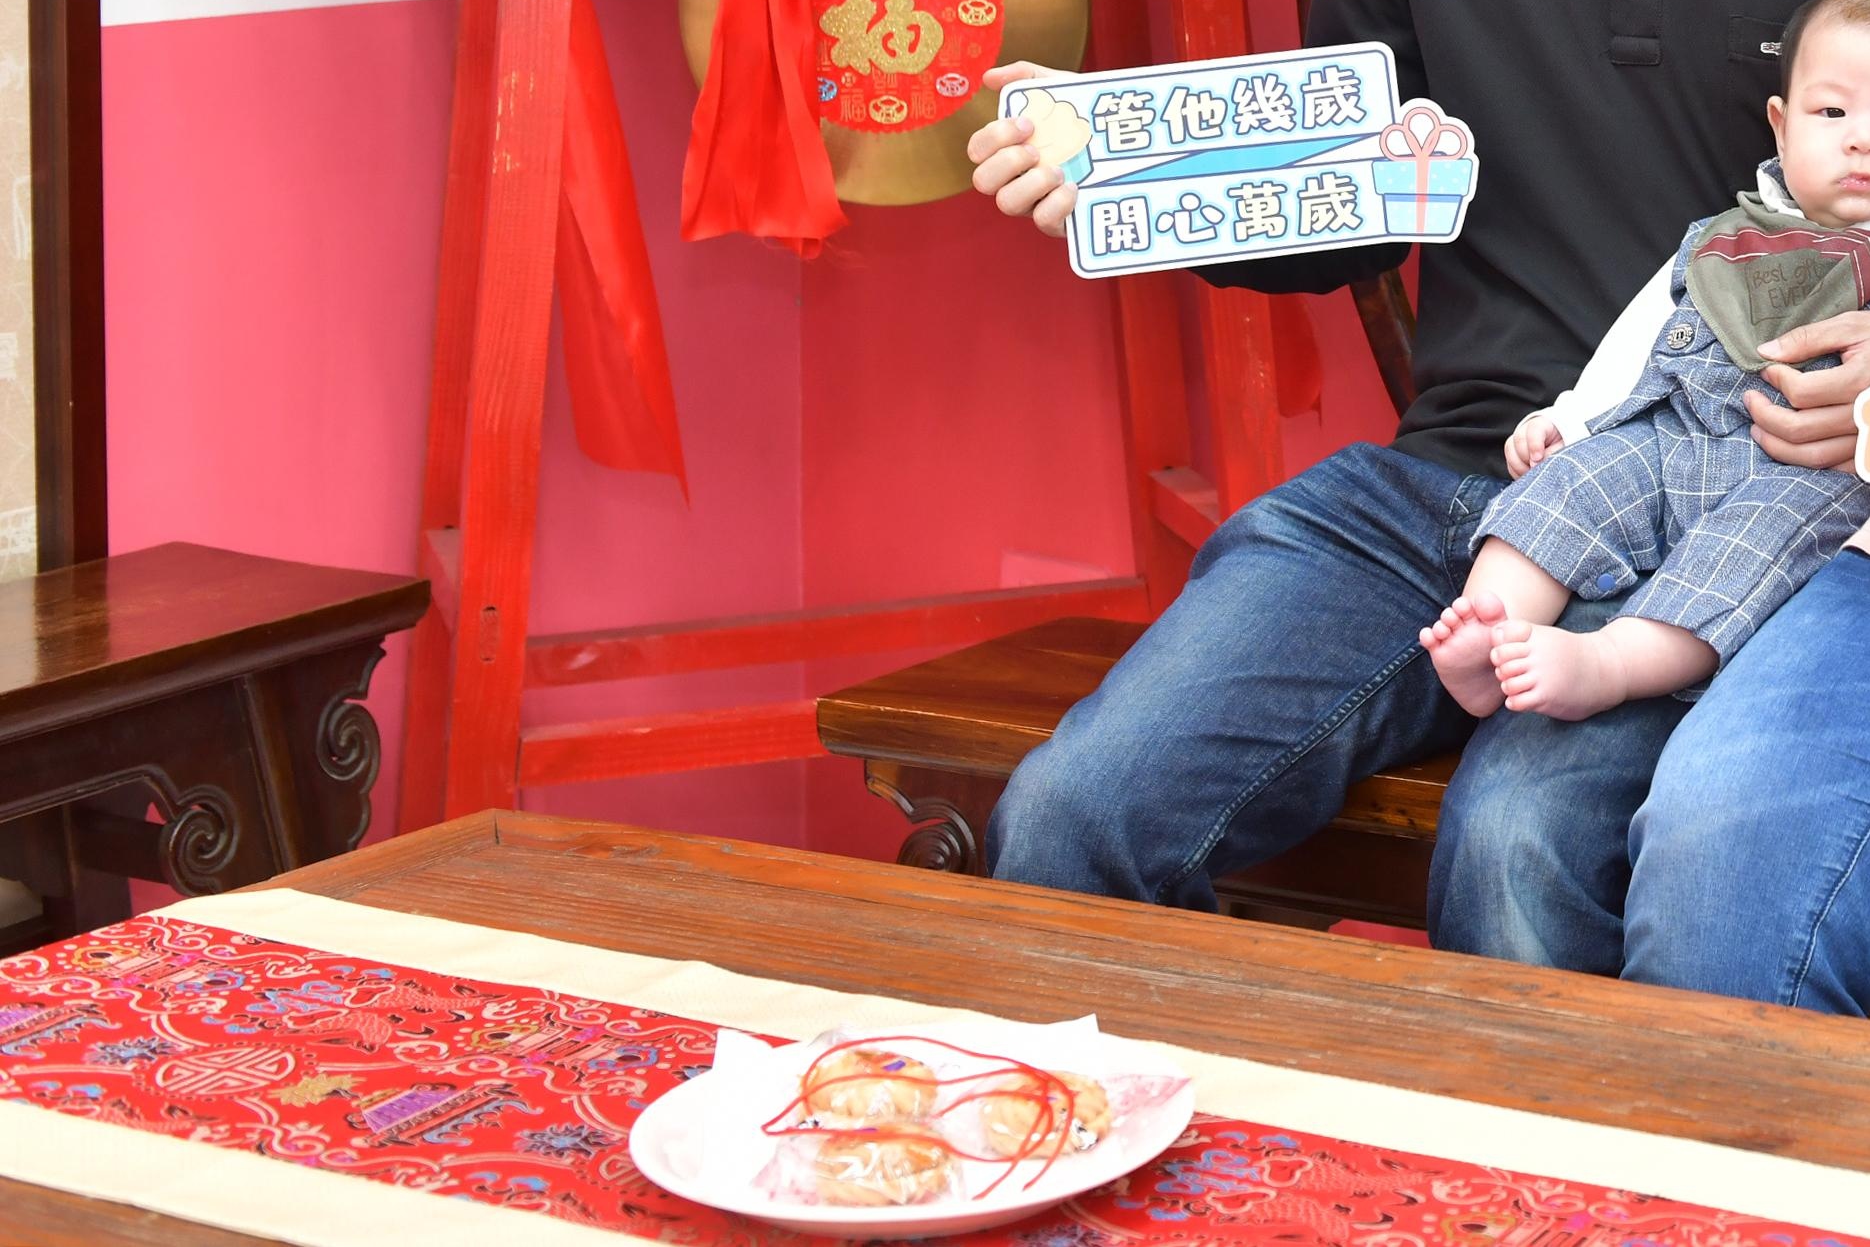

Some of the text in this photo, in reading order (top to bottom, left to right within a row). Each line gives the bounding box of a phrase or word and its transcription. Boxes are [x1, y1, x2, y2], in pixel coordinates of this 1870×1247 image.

[1093, 65, 1367, 154] 管他幾歲
[1090, 171, 1364, 257] 開心萬歲
